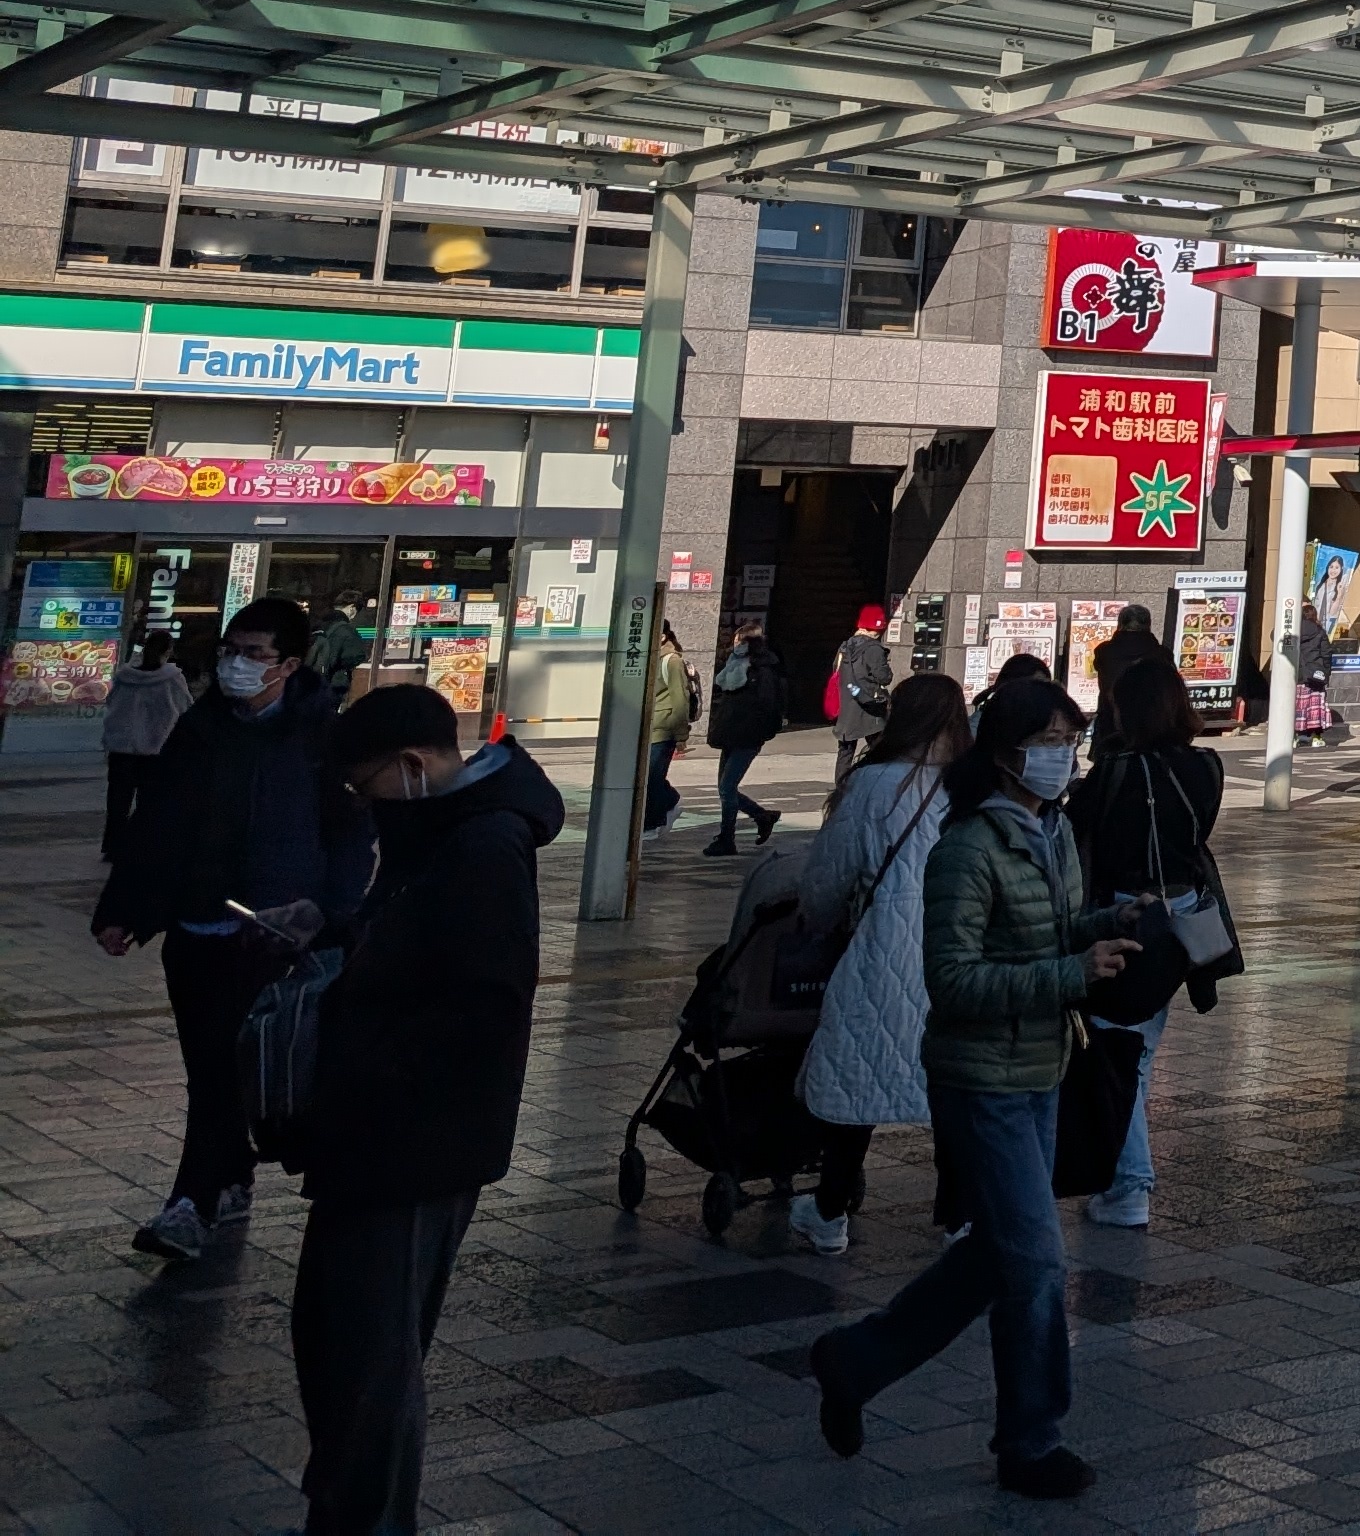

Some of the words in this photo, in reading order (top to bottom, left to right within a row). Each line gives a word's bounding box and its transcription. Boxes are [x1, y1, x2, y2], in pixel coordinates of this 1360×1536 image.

[1057, 307, 1098, 342] B1
[178, 339, 420, 389] FamilyMart
[1080, 388, 1177, 415] 浦和駅前
[1050, 416, 1199, 444] トマト歯科医院
[228, 476, 342, 497] いちご狩り
[1051, 473, 1071, 484] 歯科
[1050, 486, 1091, 498] 矯正歯科
[1145, 491, 1173, 512] 5F
[1049, 500, 1090, 511] 小児歯科
[1048, 514, 1109, 526] 歯科口腔外科
